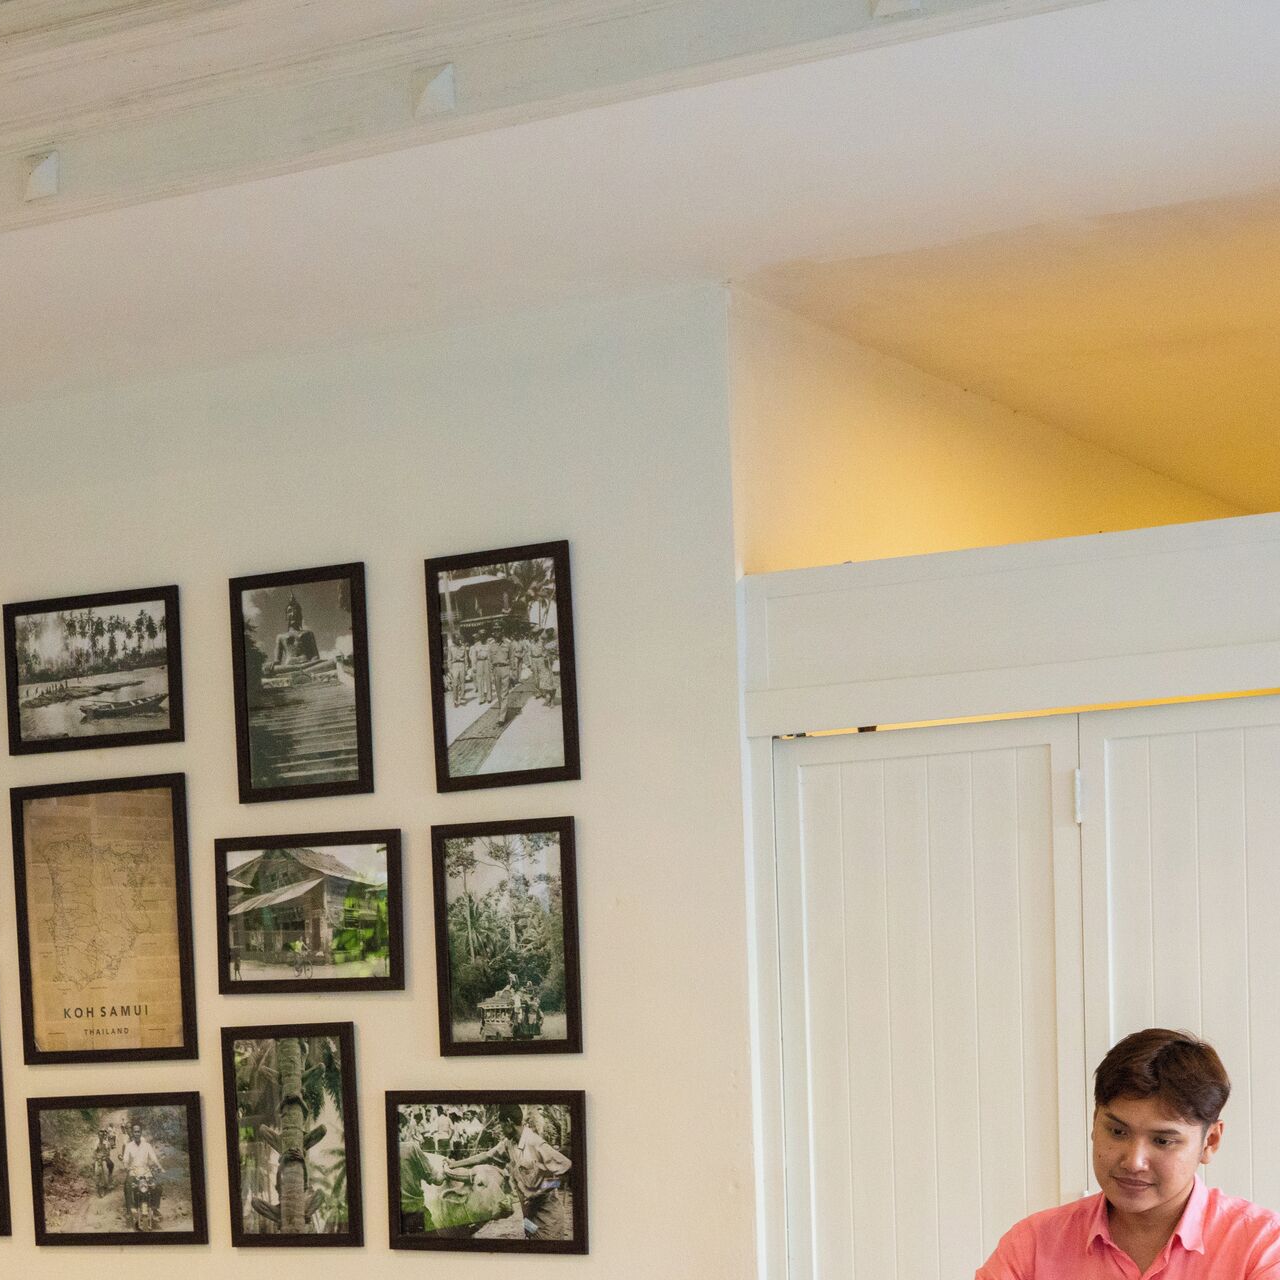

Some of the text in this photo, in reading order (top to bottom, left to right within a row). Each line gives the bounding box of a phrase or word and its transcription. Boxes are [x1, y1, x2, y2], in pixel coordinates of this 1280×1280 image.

[63, 1005, 148, 1019] KOH SAMUI
[84, 1027, 129, 1036] THAILAND
